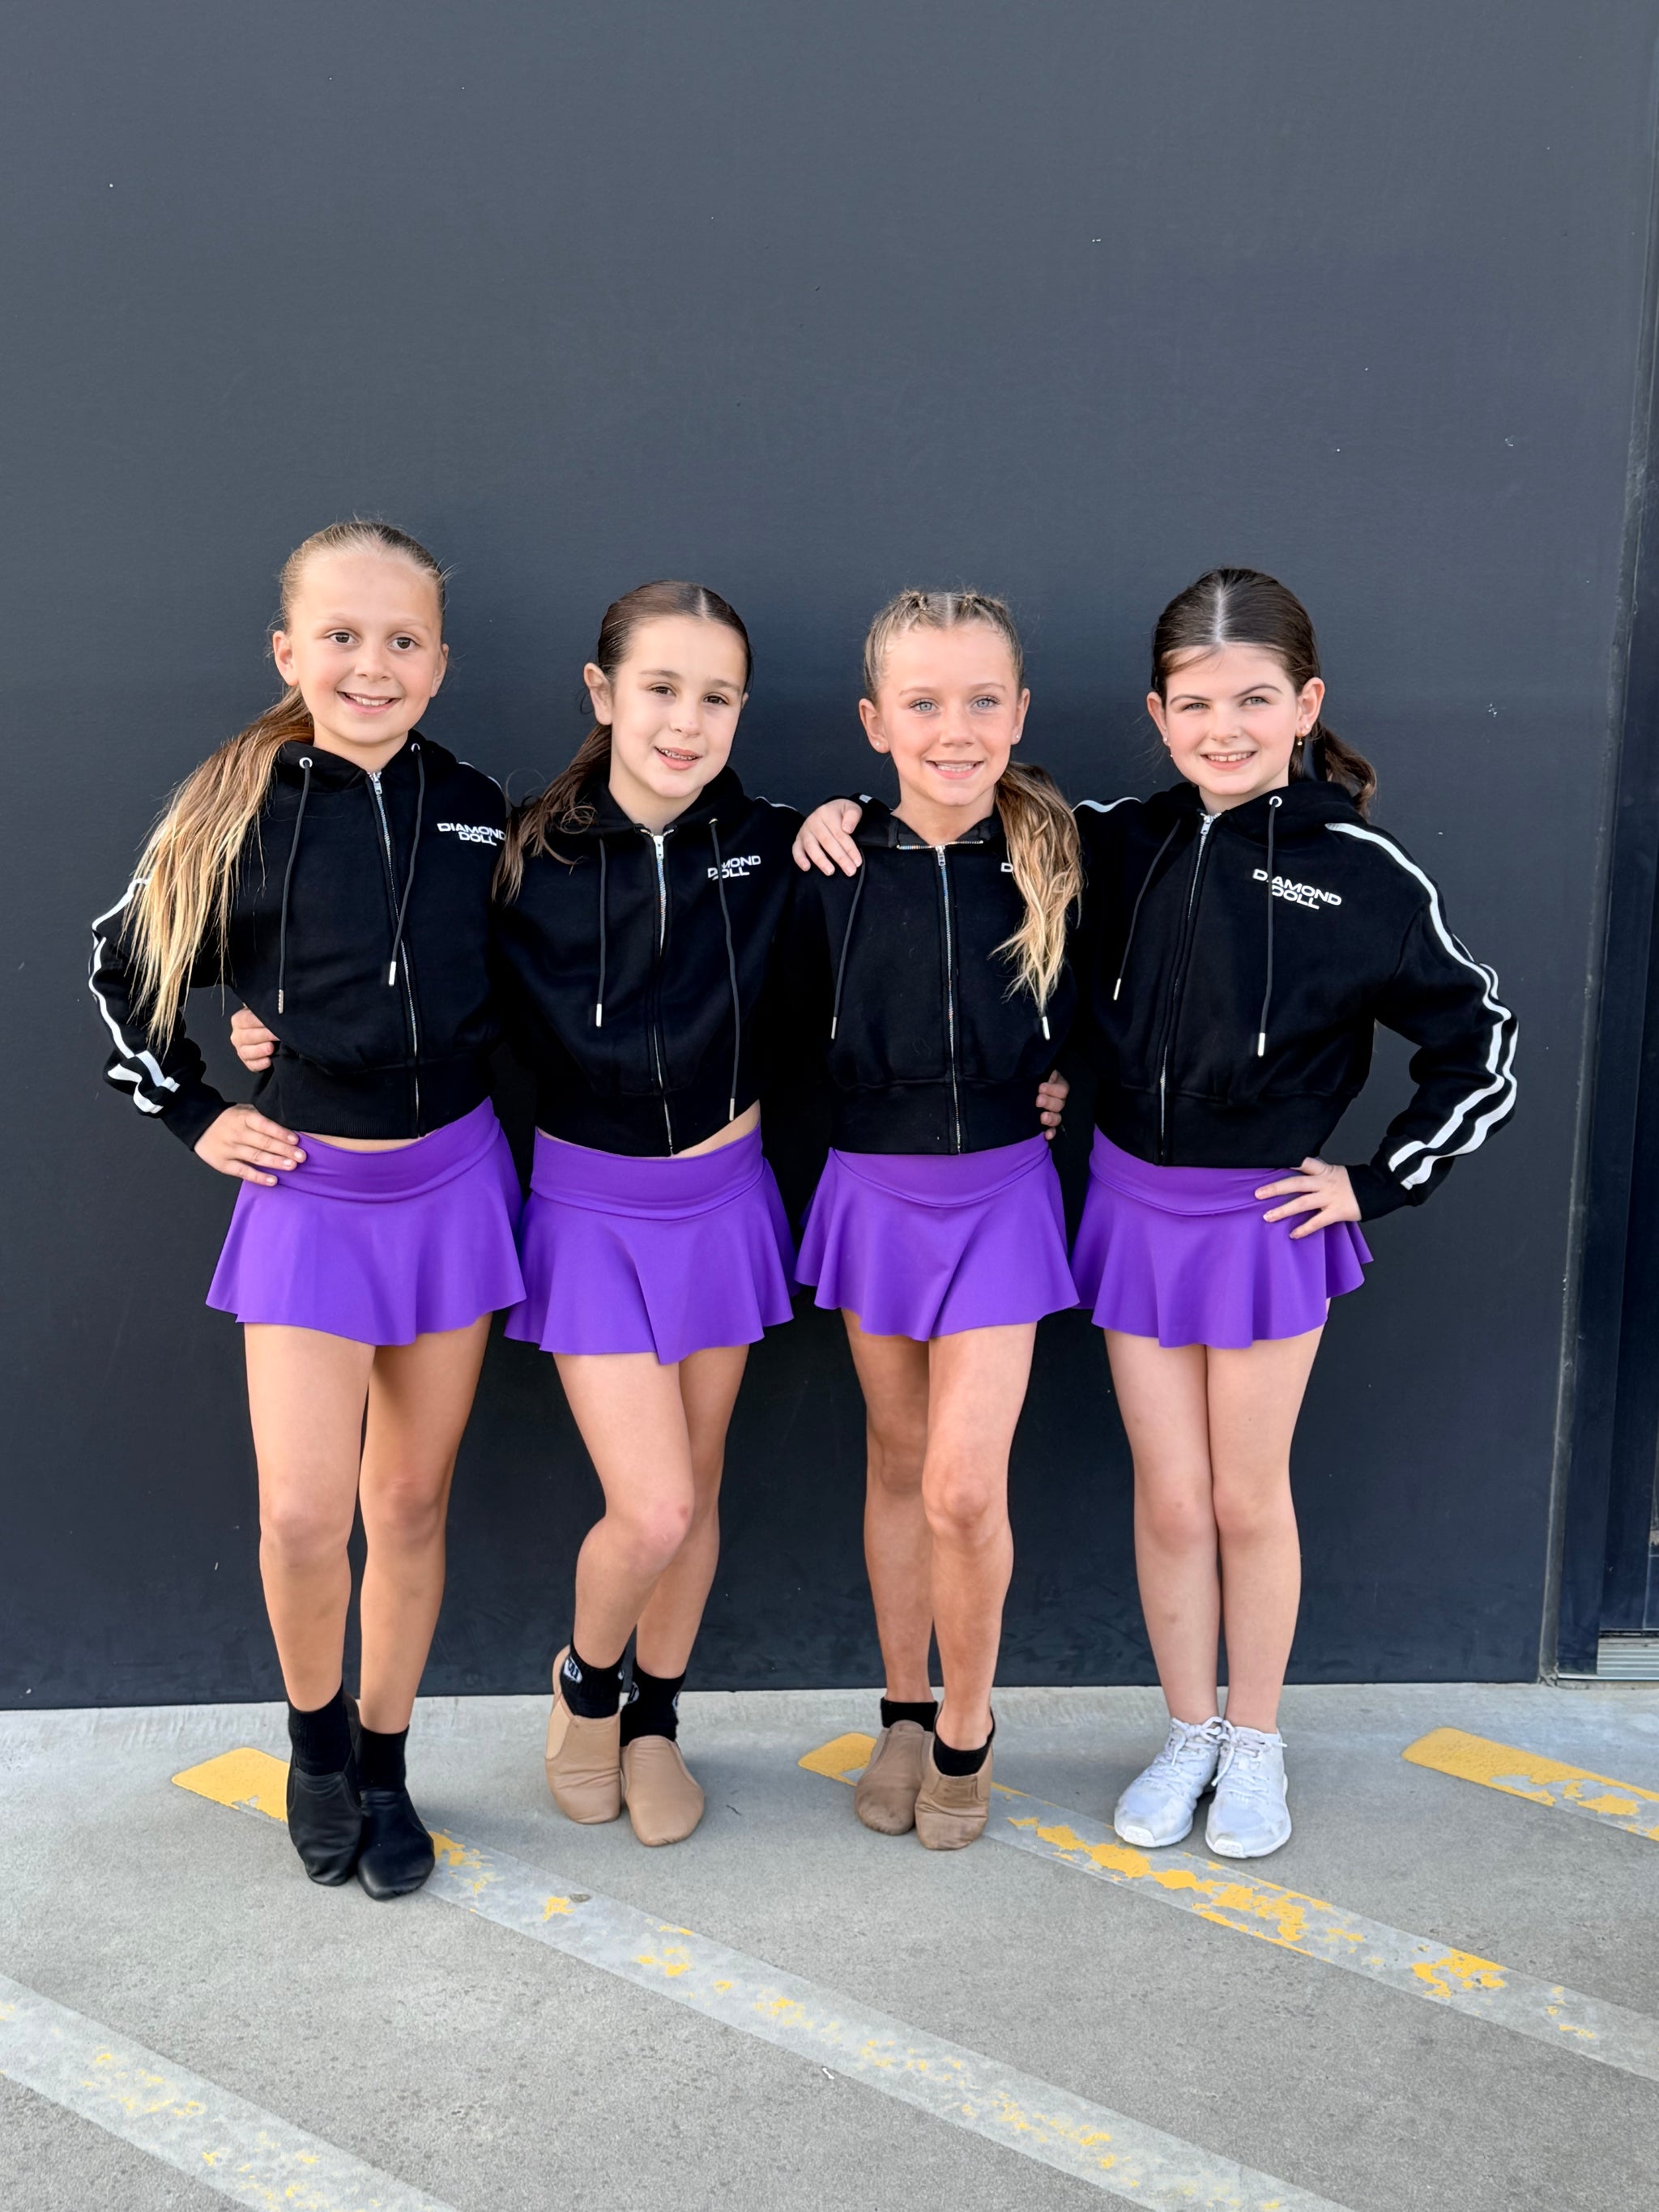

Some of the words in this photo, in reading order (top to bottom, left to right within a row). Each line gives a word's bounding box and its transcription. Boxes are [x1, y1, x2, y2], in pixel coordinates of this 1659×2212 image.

[437, 823, 506, 841] DIAMOND
[458, 831, 497, 846] DOLL
[1252, 868, 1342, 906] DAMOND
